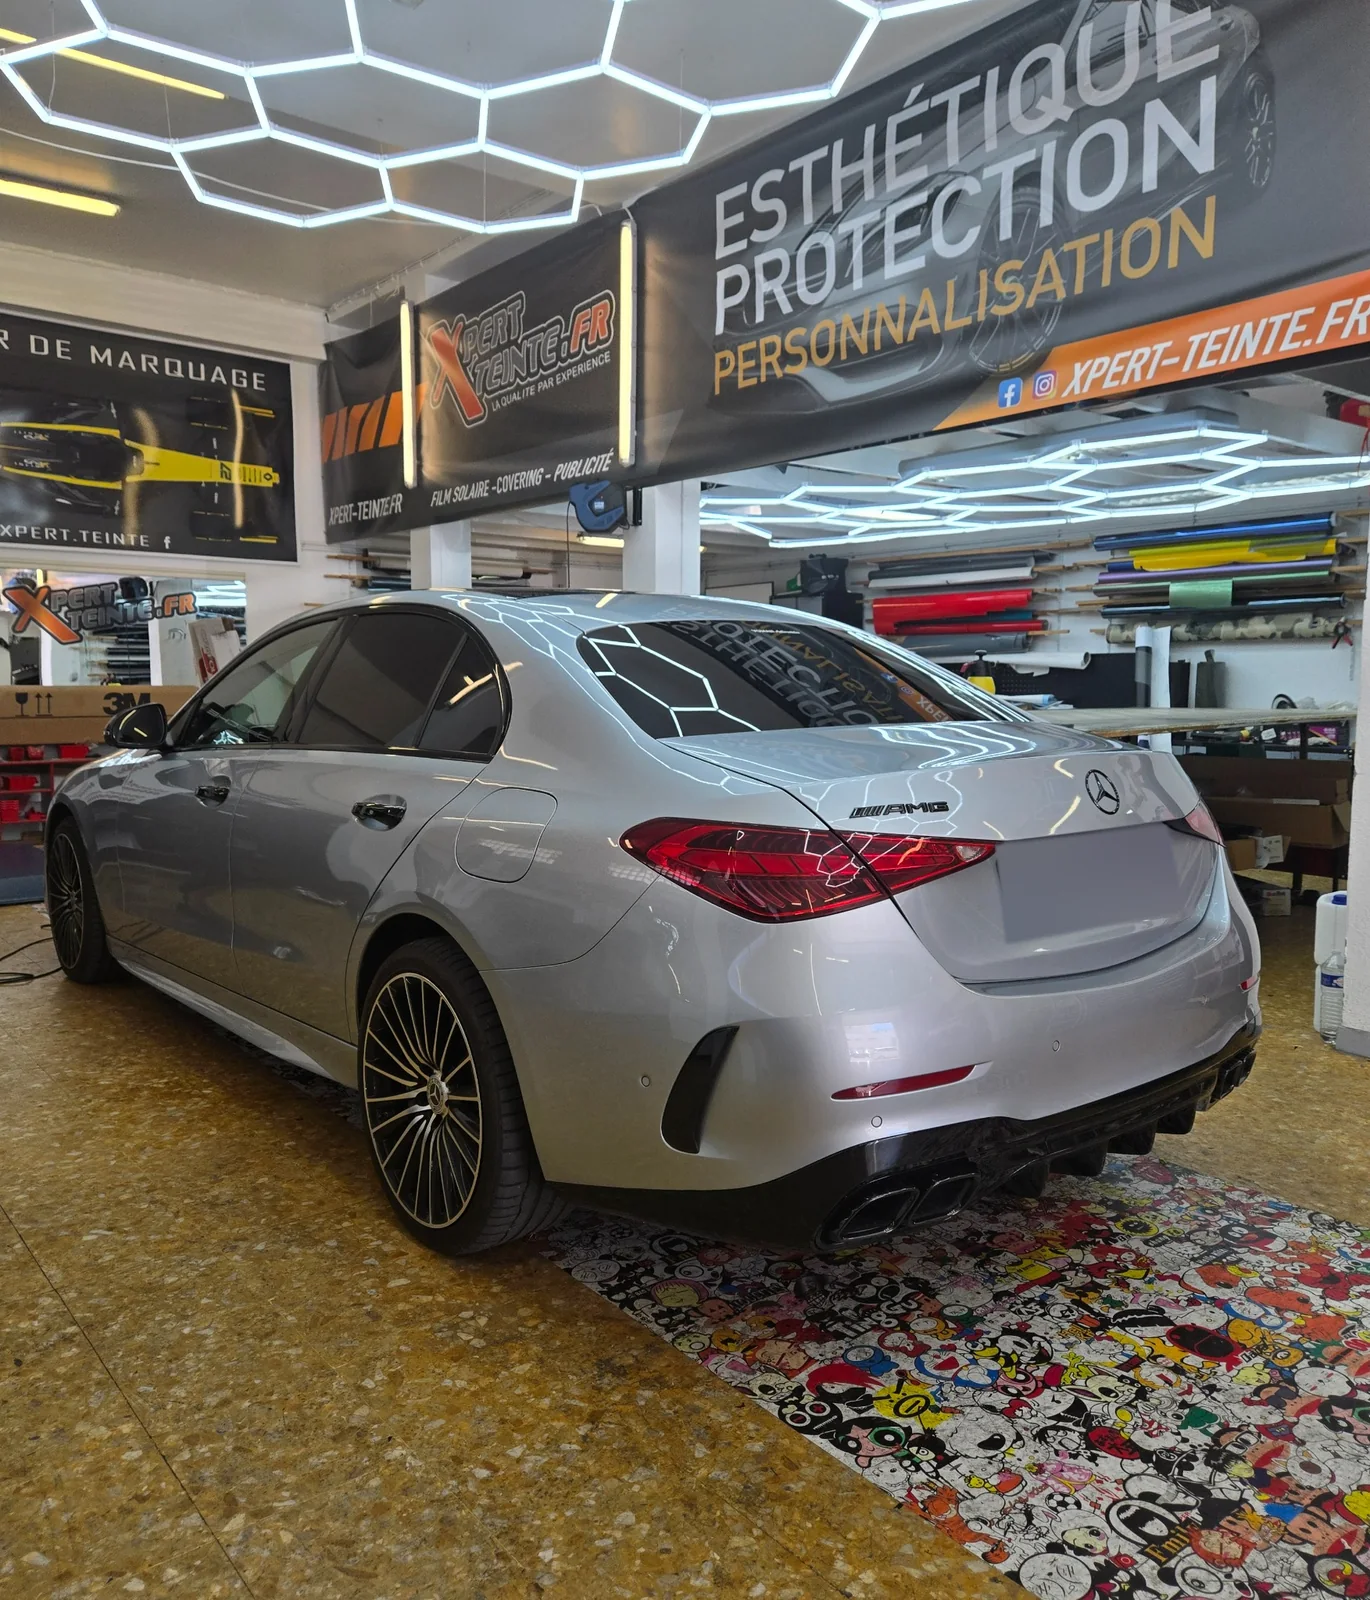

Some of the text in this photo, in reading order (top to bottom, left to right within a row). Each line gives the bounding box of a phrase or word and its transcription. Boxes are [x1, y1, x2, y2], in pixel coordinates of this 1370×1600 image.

[715, 0, 1219, 261] ESTHÉTIQUE
[715, 75, 1216, 335] PROTECTION
[714, 196, 1216, 395] PERSONNALISATION
[30, 334, 72, 360] DE
[90, 345, 266, 391] MARQUAGE
[429, 297, 523, 421] XPERT
[474, 299, 611, 396] TEINTE.FR
[1061, 294, 1370, 398] XPERT-TEINTE.FR
[491, 350, 611, 411] LA QUALITE PAR EXPERIENCE
[430, 487, 451, 507] FILM
[452, 479, 490, 502] SOLAIRE
[554, 448, 615, 482] PUBLICITÉ
[0, 524, 150, 547] XPERT.TEINTE
[4, 583, 117, 644] XPERT
[67, 594, 195, 631] TEINTE.FR
[103, 692, 151, 715] 3M
[882, 801, 949, 816] AMG
